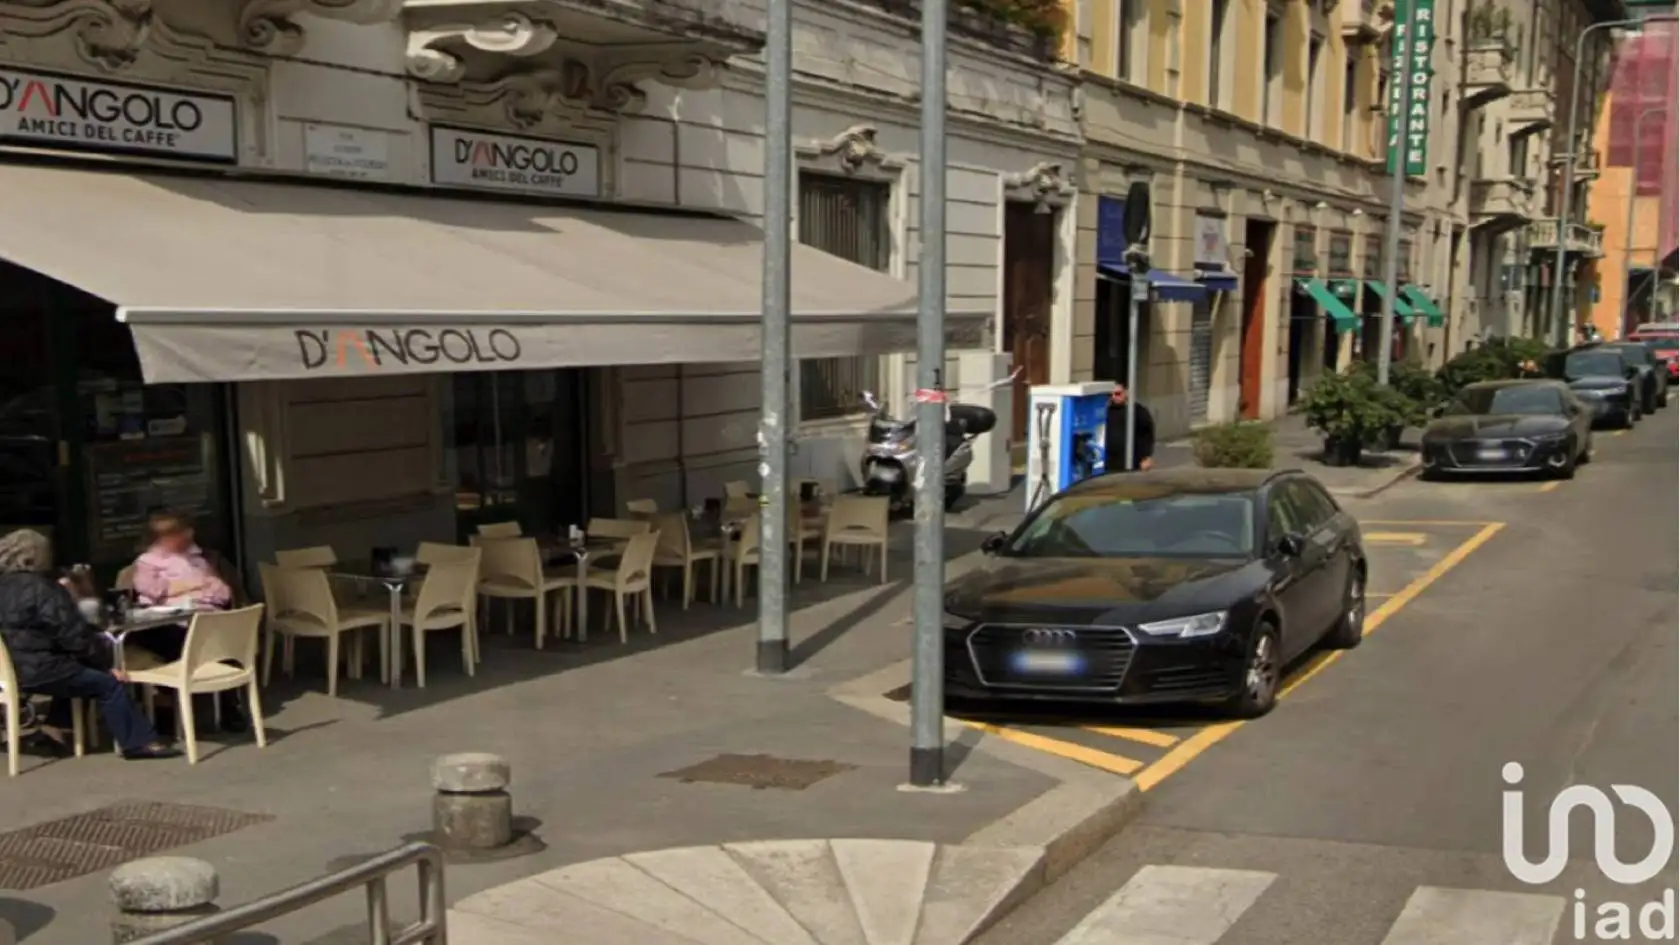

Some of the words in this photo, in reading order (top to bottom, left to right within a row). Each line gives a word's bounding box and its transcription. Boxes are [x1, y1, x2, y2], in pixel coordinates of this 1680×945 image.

[1408, 8, 1431, 163] RISTORANTE
[18, 116, 77, 138] AMICI
[85, 123, 117, 142] DEL
[454, 138, 578, 176] D'ANGOLO
[472, 167, 506, 182] AMICI
[508, 171, 529, 185] DEL
[294, 328, 522, 370] D'ANGOLO
